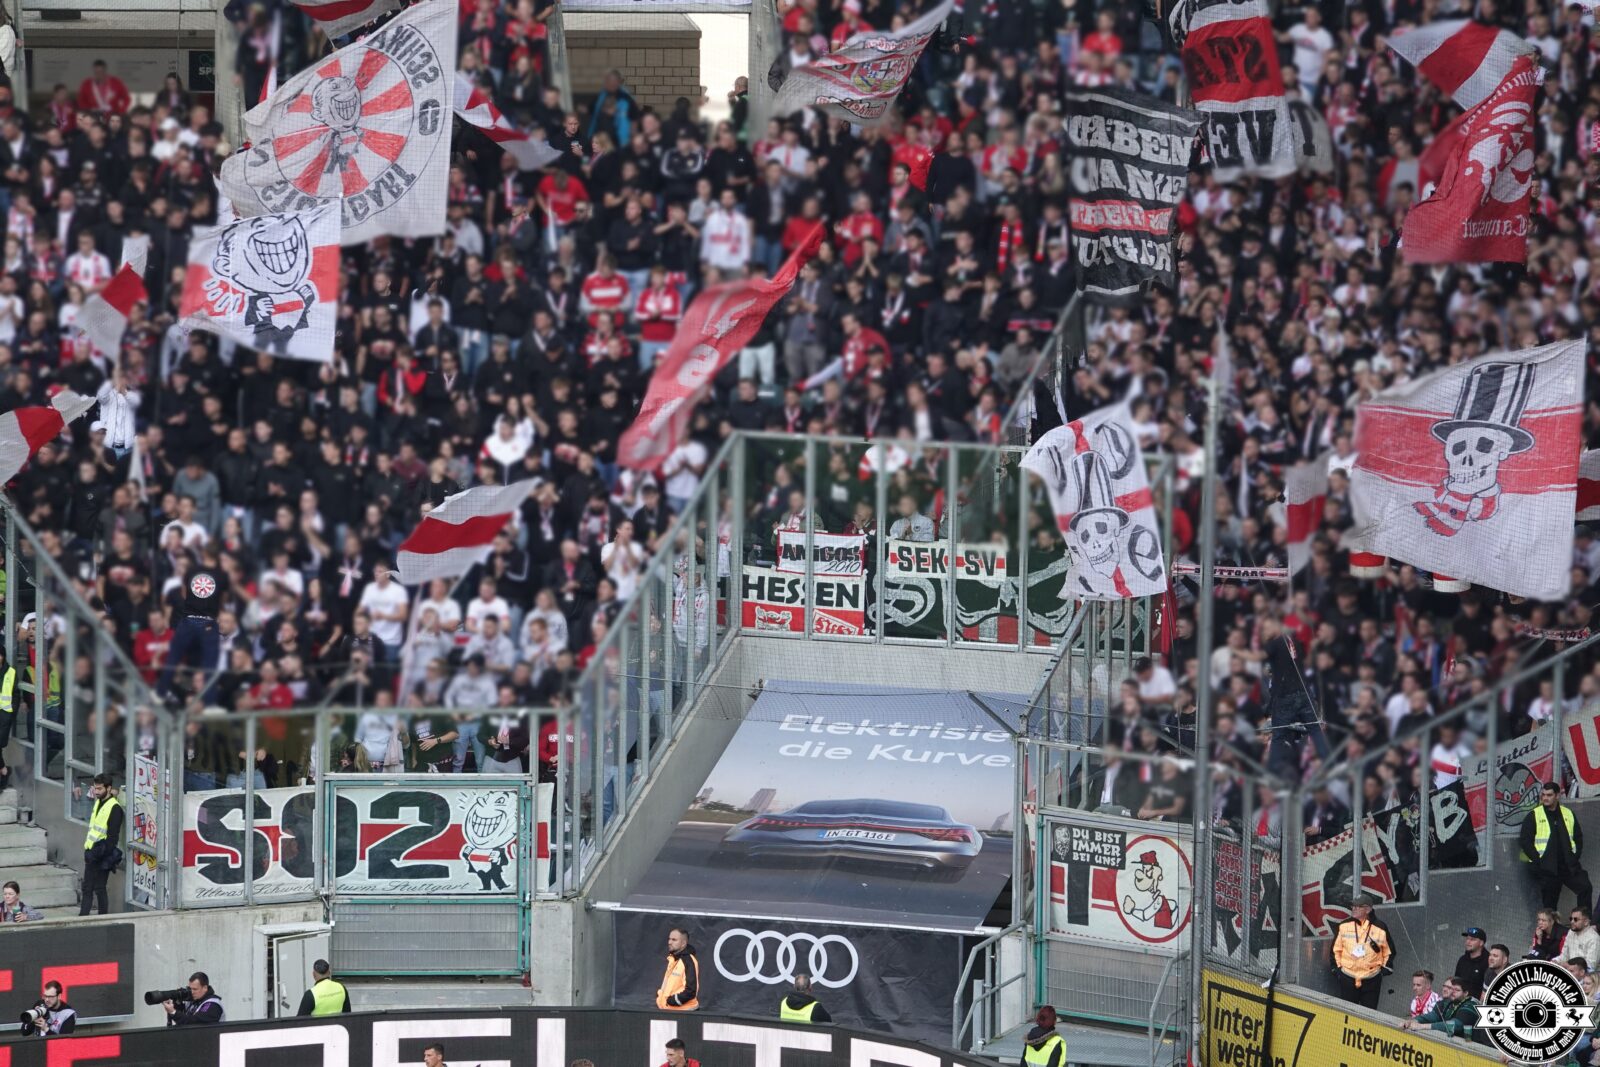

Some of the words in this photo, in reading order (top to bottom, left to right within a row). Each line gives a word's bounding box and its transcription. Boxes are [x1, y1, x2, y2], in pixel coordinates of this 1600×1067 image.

[825, 560, 861, 573] 2010
[898, 546, 946, 574] SEK
[965, 550, 997, 577] SV
[778, 741, 853, 760] die
[1072, 828, 1090, 840] DU
[1094, 831, 1121, 844] BIST
[1072, 839, 1121, 857] IMMER
[1072, 852, 1090, 862] BEI
[1094, 854, 1122, 867] UNS!
[382, 880, 470, 894] Stuttgart
[1213, 990, 1264, 1041] inter
[1341, 1015, 1434, 1067] interwetten
